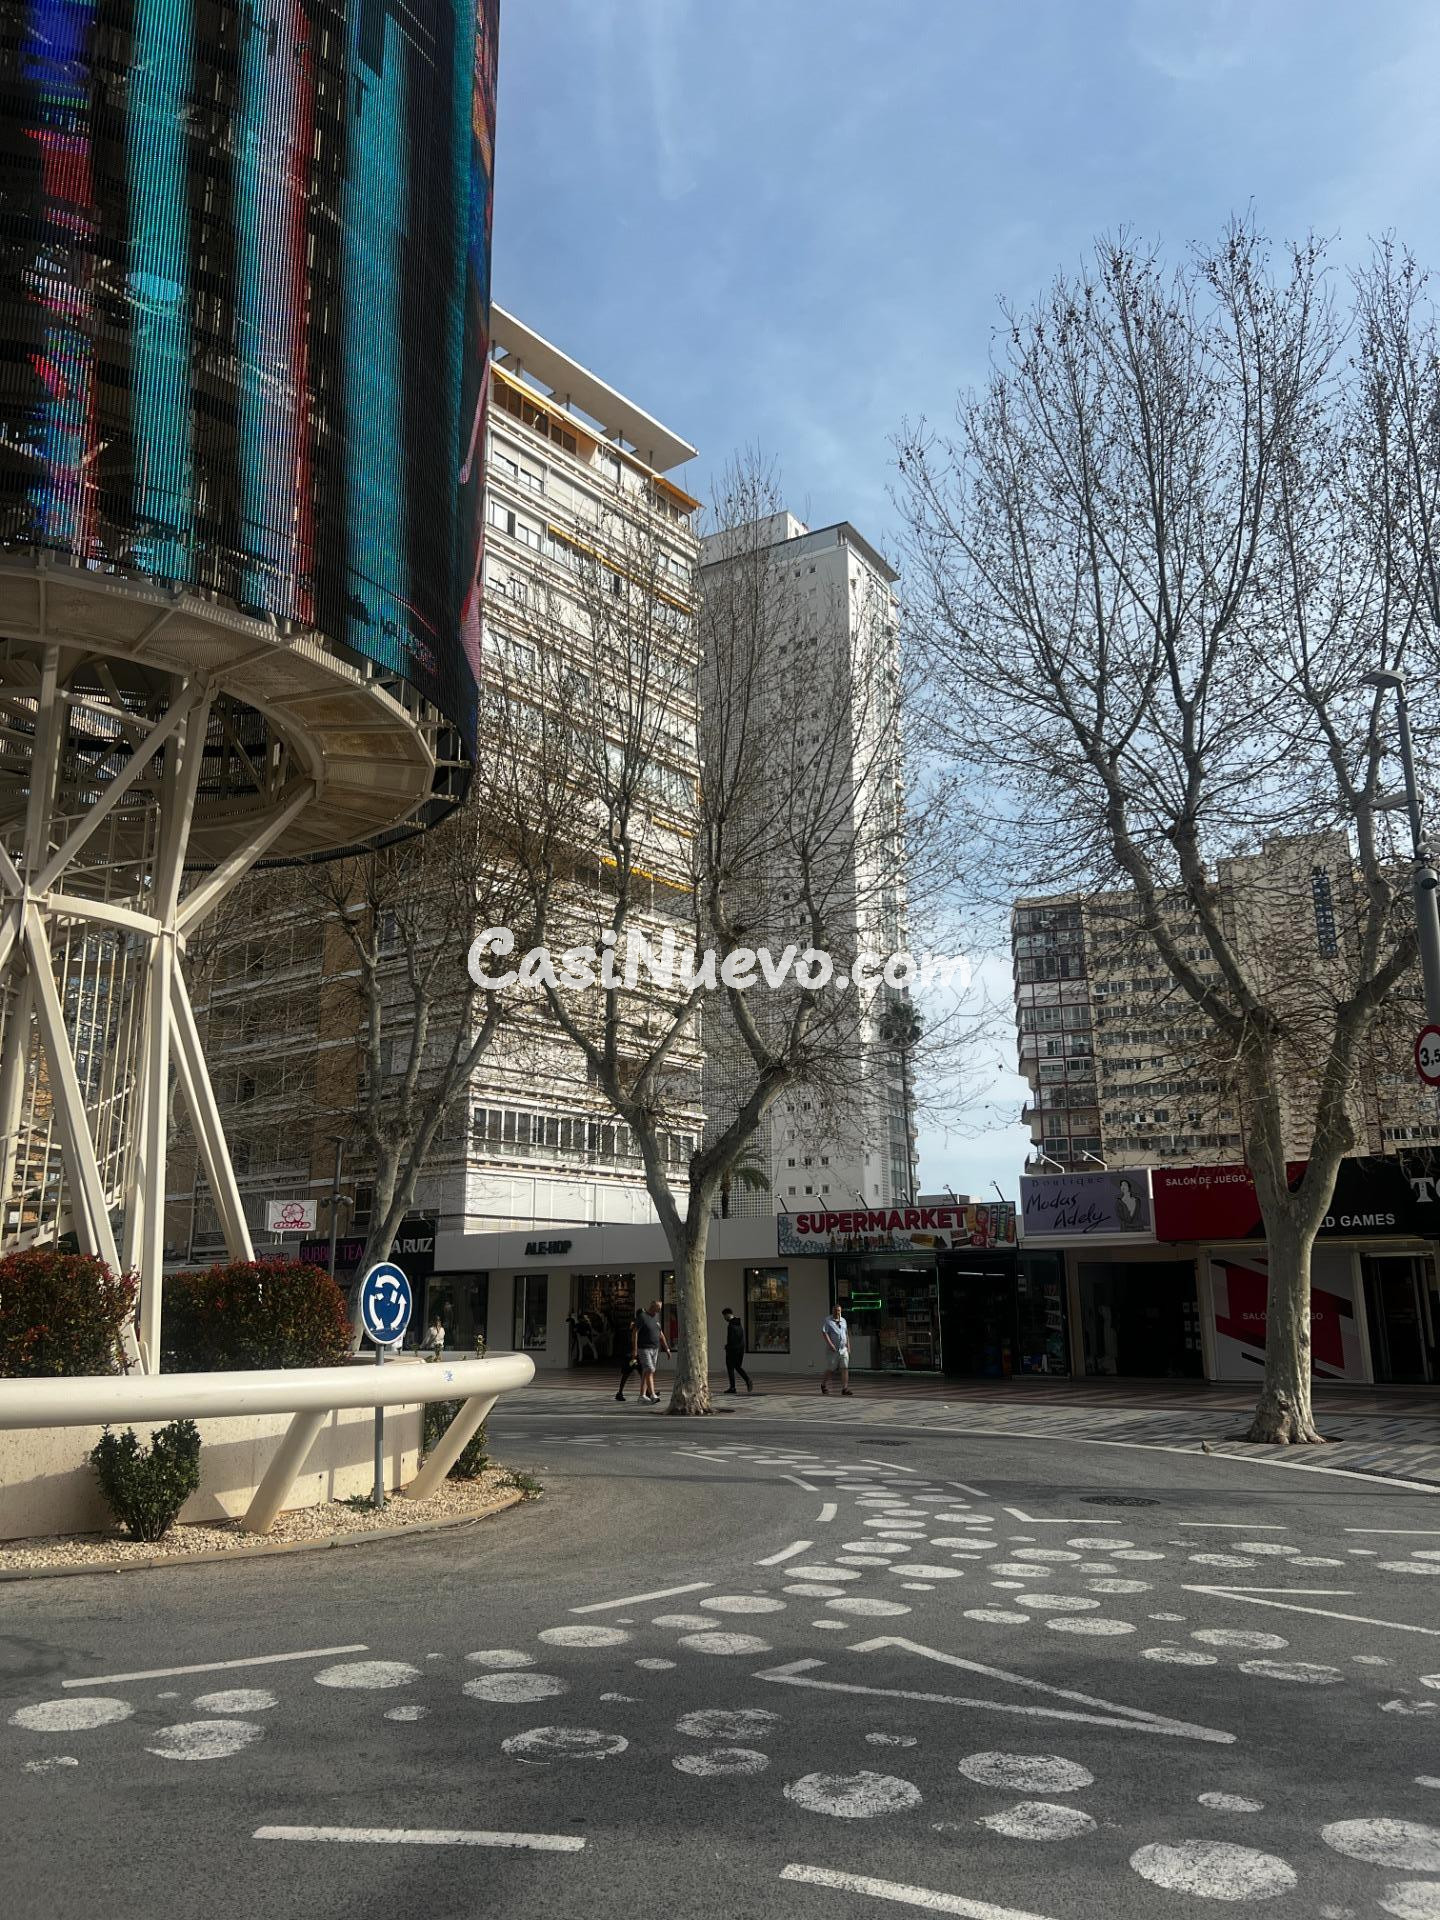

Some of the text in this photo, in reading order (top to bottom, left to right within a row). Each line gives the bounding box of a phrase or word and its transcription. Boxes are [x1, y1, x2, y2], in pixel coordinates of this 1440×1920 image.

[1199, 1176, 1211, 1185] DE
[1214, 1174, 1247, 1184] JUEGO
[1026, 1190, 1080, 1214] Modas
[273, 1221, 312, 1230] doria
[796, 1206, 969, 1234] SUPERMARKET
[1340, 1213, 1396, 1227] GAMES
[341, 1243, 364, 1261] TEA
[403, 1238, 433, 1253] RUIZ
